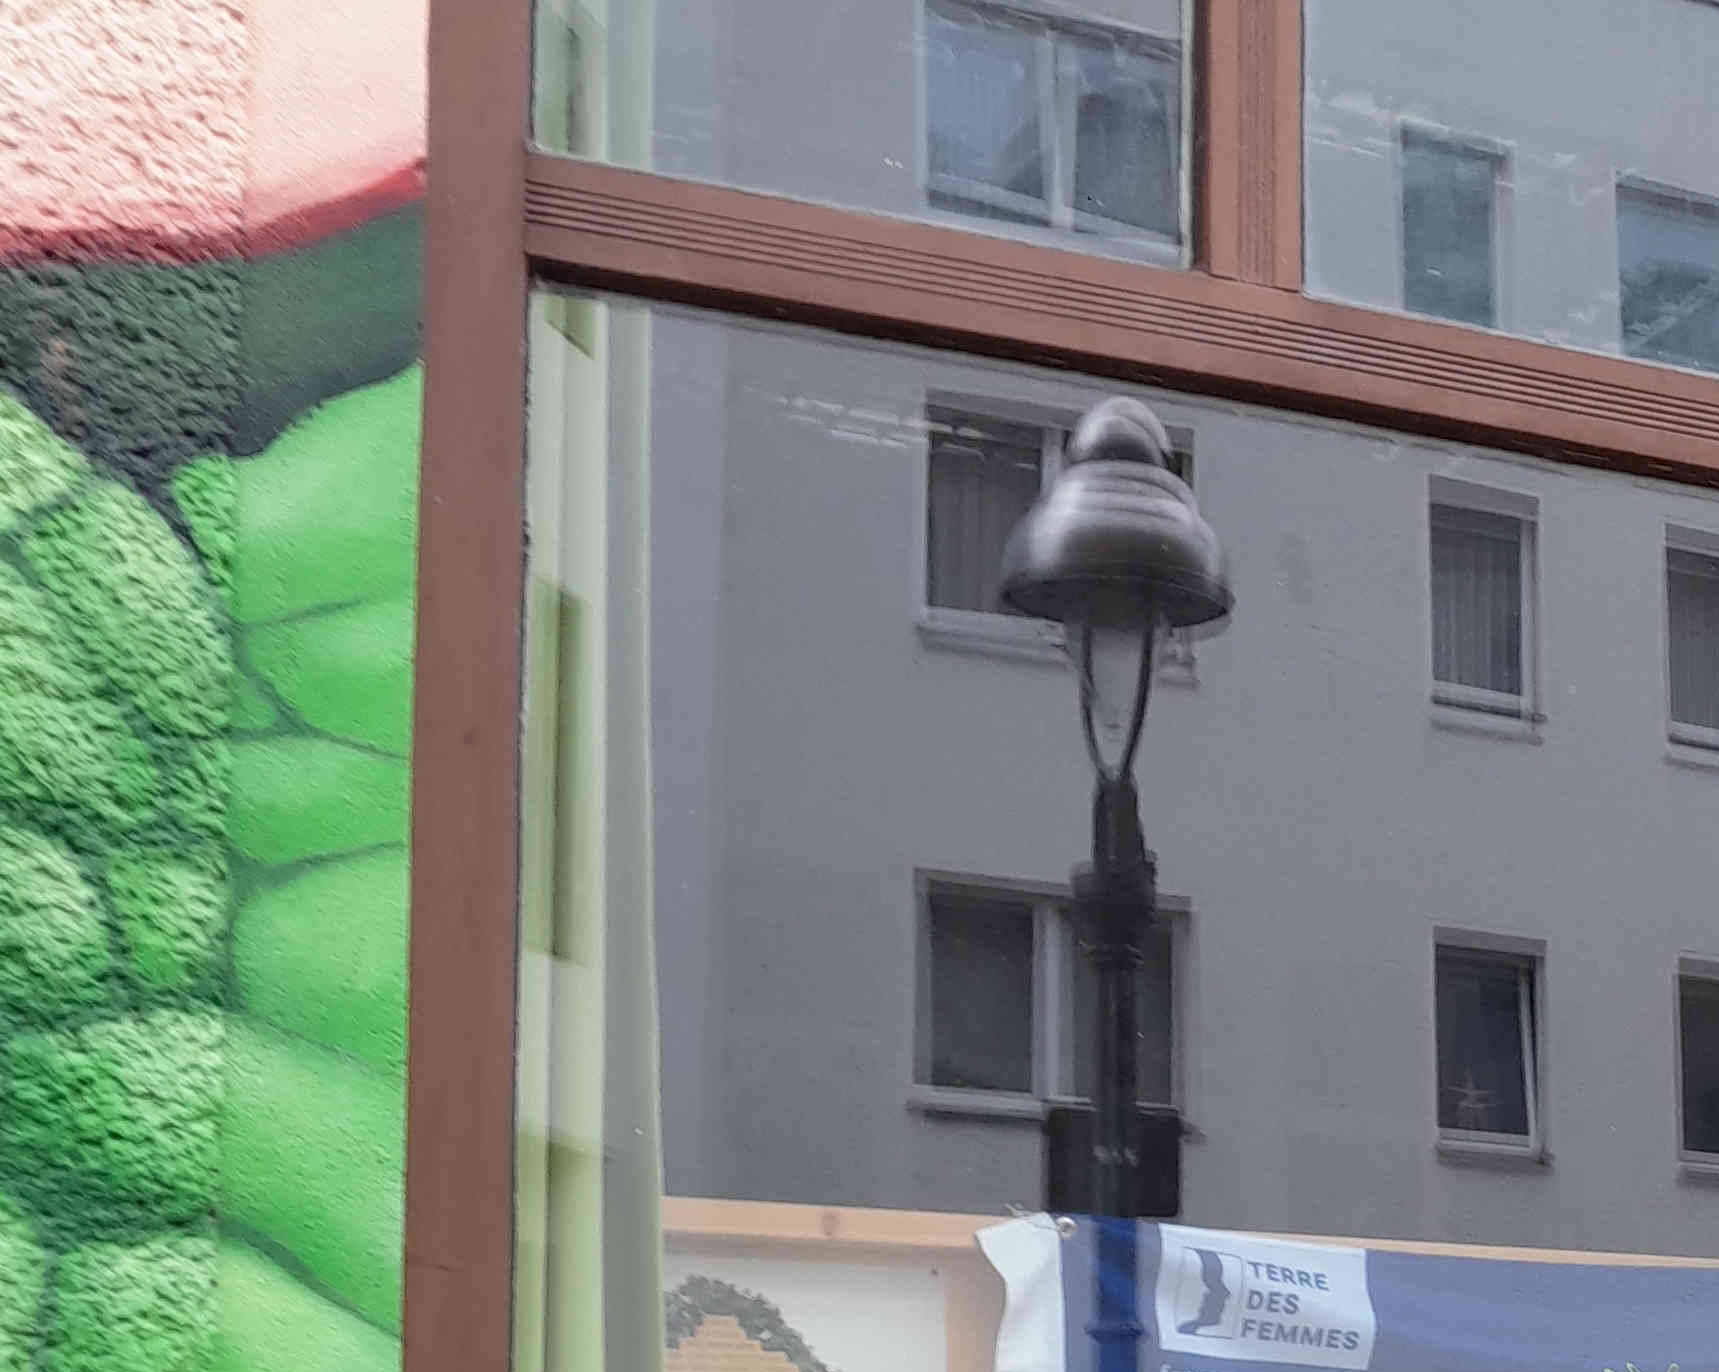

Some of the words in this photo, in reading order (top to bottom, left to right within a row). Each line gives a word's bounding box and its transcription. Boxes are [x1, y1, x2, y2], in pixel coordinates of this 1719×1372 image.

[1248, 1261, 1329, 1291] TERRE
[1247, 1290, 1300, 1315] DES
[1241, 1319, 1360, 1351] FEMMES
